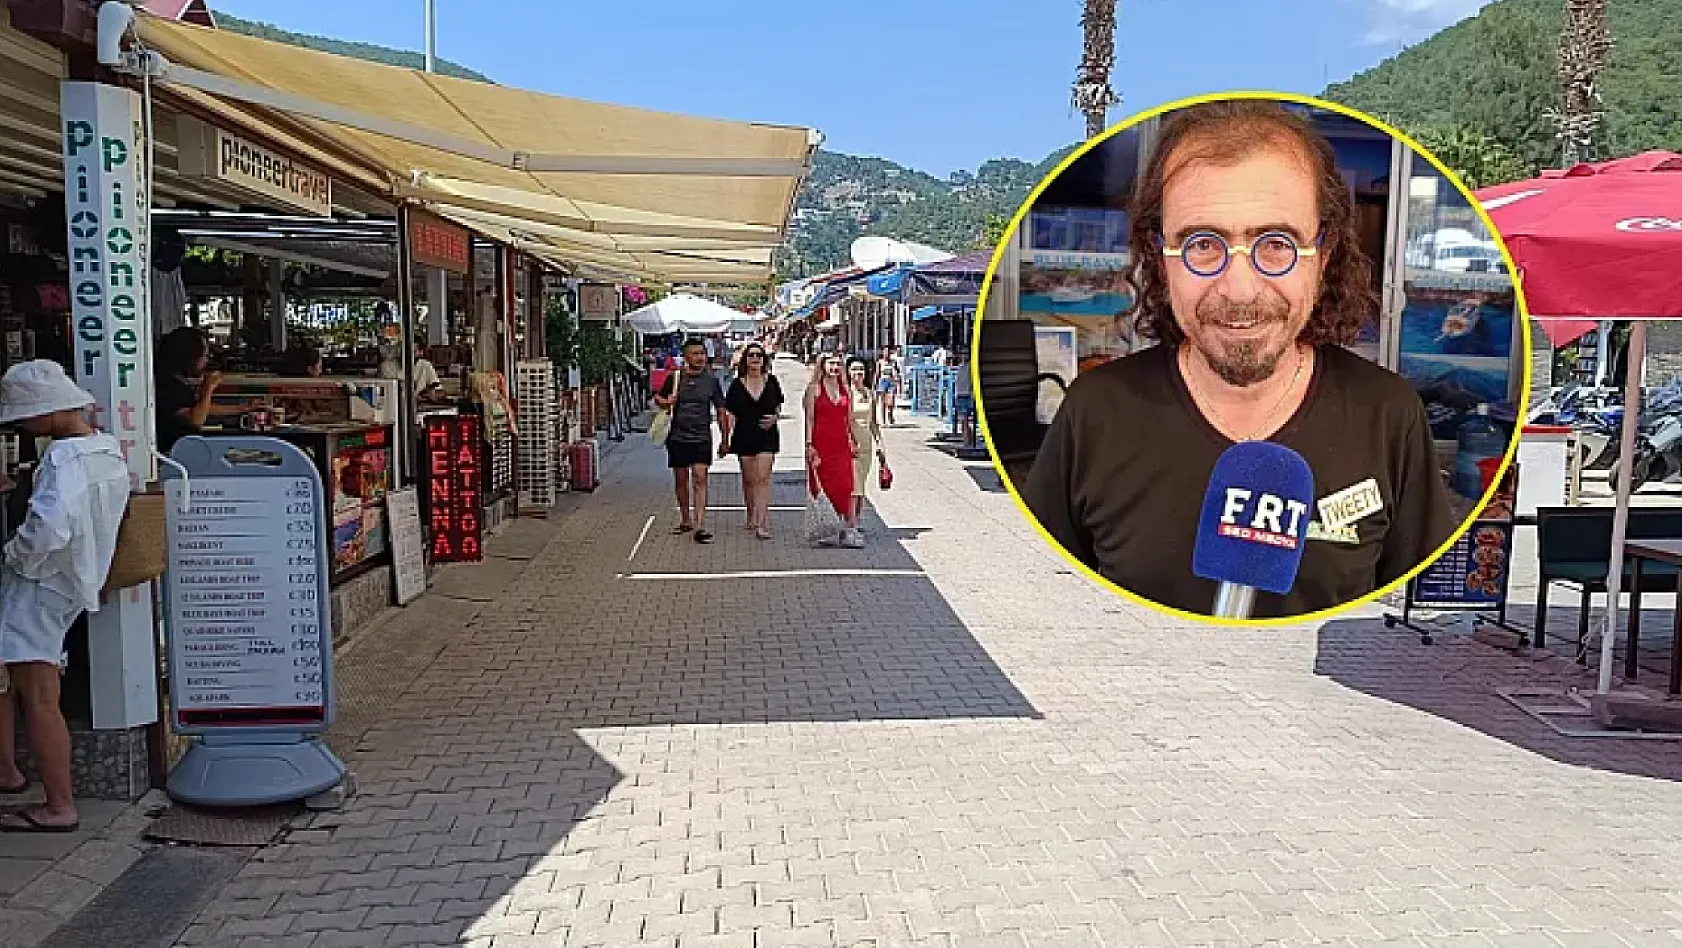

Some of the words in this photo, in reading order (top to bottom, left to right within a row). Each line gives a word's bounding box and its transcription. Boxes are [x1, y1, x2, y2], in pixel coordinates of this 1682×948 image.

[221, 136, 328, 205] pioneertravel
[67, 120, 103, 376] pioneer
[101, 136, 137, 388] pioneer
[429, 423, 451, 554] HENNA
[458, 420, 478, 554] TATTOO
[1321, 484, 1379, 527] TWEETY
[1220, 488, 1307, 537] FRT
[212, 558, 233, 566] BOAT
[219, 575, 241, 585] BOAT
[288, 574, 315, 584] £20
[224, 592, 245, 601] BOAT
[246, 592, 265, 601] TRIP
[224, 609, 246, 618] BOAT
[211, 659, 241, 668] DIVING
